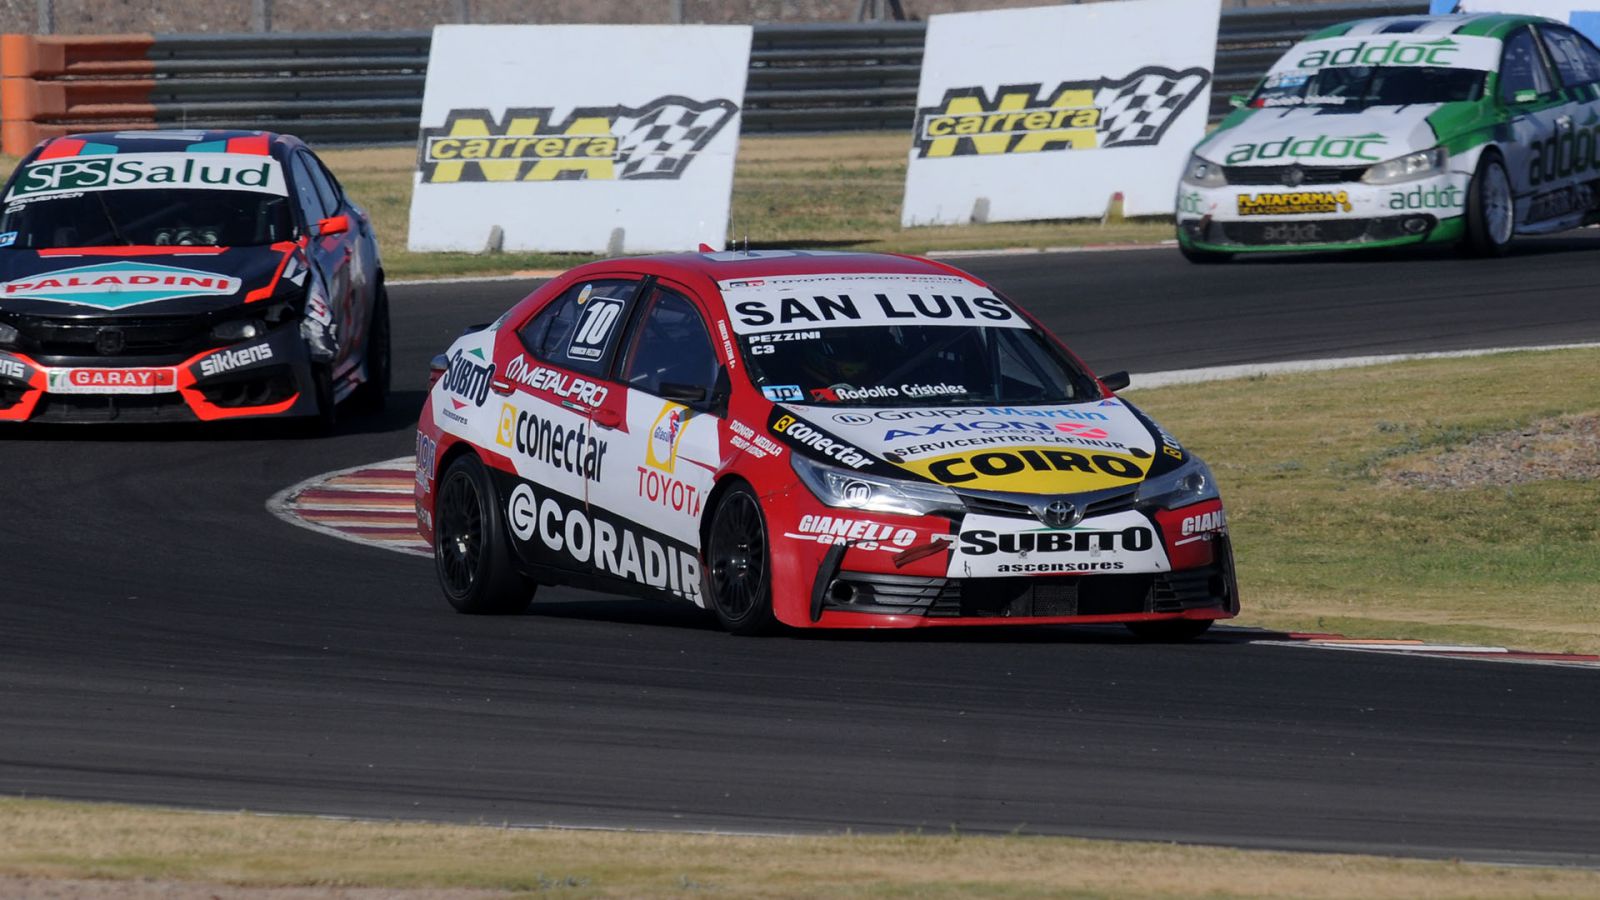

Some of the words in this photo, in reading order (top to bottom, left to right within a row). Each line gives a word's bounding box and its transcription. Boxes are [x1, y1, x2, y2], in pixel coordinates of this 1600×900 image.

[1297, 40, 1460, 68] addoc
[927, 109, 1102, 136] carrera
[430, 136, 617, 159] carrera
[1226, 135, 1388, 164] addoc
[24, 160, 107, 191] SPS
[113, 158, 271, 188] Salud
[1238, 191, 1337, 208] PLATAFORMA
[1389, 185, 1464, 210] addoc
[5, 275, 230, 294] PALADINI
[575, 301, 620, 345] 10
[735, 293, 862, 327] SAN
[874, 293, 1013, 321] LUIS
[749, 331, 821, 345] PEZZINI
[751, 345, 776, 356] C3
[200, 343, 273, 376] sikkens
[75, 371, 151, 385] GARAY
[443, 348, 496, 408] SUBITO
[516, 363, 609, 408] METALPRO
[836, 386, 899, 401] Rodolfo
[901, 382, 967, 398] Cristales
[729, 419, 755, 440] DONAR
[754, 434, 783, 457] MEDULA
[884, 420, 1052, 441] AXION
[516, 410, 608, 483] conectar
[786, 422, 875, 469] conectar
[895, 435, 1036, 457] SERVICENTRO
[1041, 435, 1127, 450] LAFINUR
[928, 450, 1145, 484] COIRO
[850, 487, 867, 501] 10
[539, 498, 706, 608] CORADIR
[959, 526, 1153, 556] SUBITO
[997, 561, 1124, 573] ascensores
